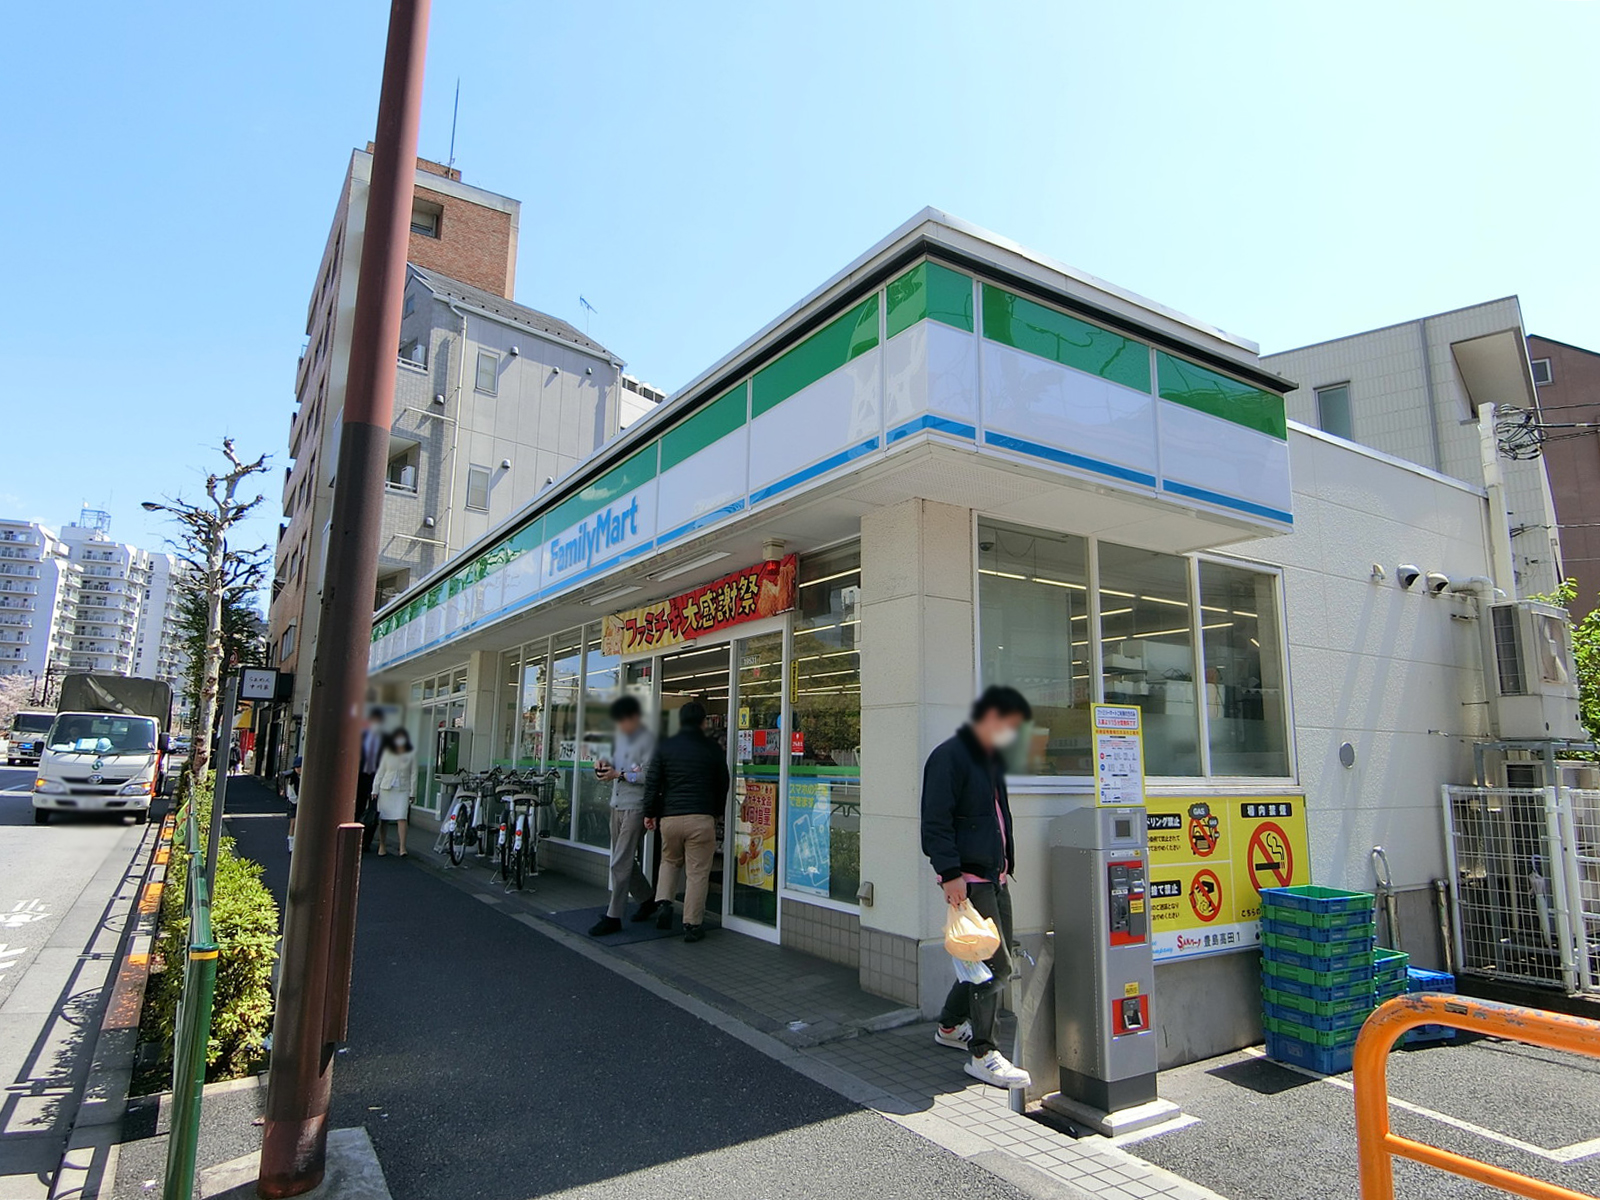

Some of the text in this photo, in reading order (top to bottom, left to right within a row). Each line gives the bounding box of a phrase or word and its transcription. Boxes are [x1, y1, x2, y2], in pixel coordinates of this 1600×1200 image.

[549, 495, 638, 577] FamilyMart
[625, 574, 760, 648] ファミチキ大感謝祭
[1192, 807, 1205, 816] GAS
